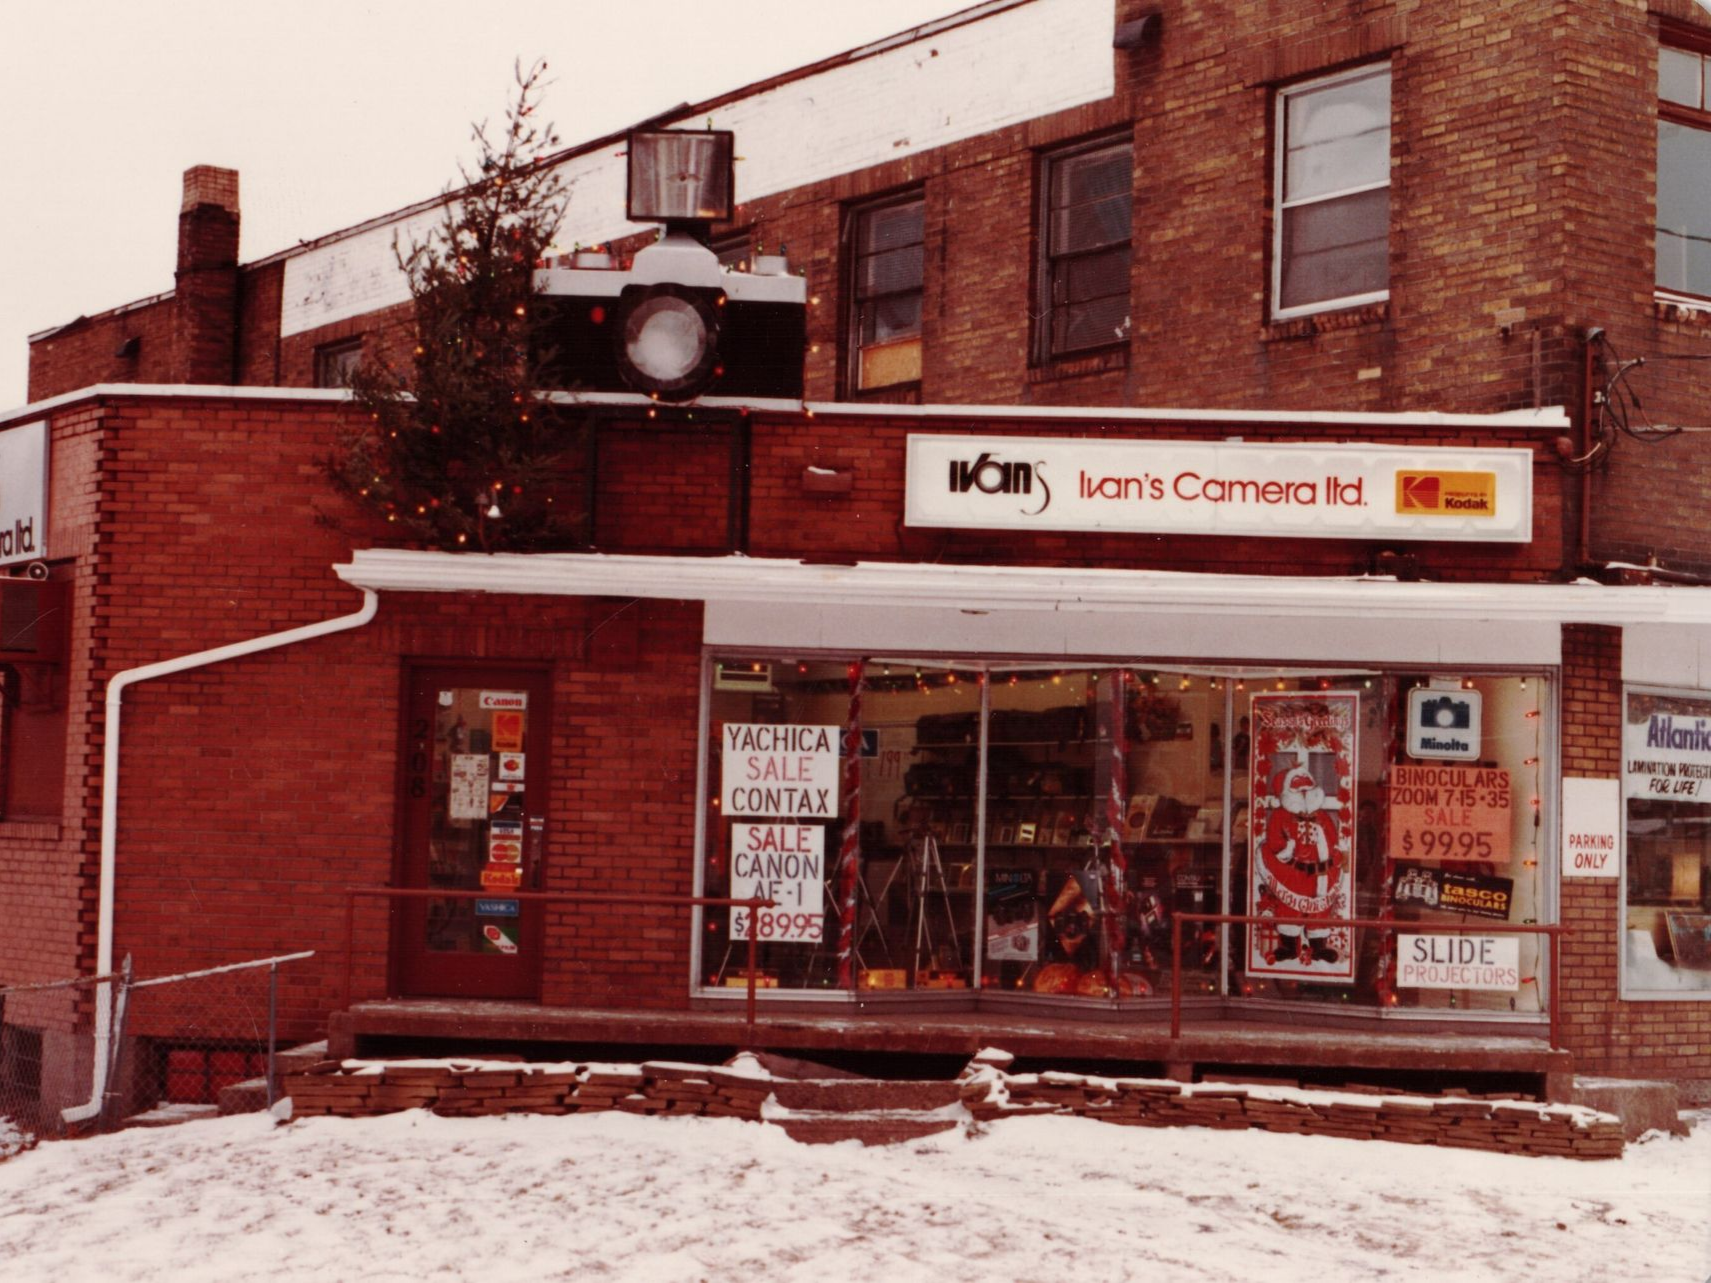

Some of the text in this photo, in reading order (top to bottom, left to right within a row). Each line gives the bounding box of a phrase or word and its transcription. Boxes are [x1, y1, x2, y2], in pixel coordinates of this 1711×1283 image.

[1079, 470, 1368, 507] Ivan's Camera ltd.
[1445, 497, 1489, 510] Kodak
[484, 696, 523, 707] Canon
[727, 725, 831, 752] YACHICA
[1420, 737, 1470, 752] Minolta
[746, 756, 813, 782] SALE
[1395, 767, 1509, 789] BINOCULARS
[1627, 760, 1676, 777] LAMINATION
[1649, 778, 1671, 794] FOR
[731, 787, 829, 814] CONTAX
[1391, 787, 1439, 807] ZOOM
[1424, 808, 1472, 827] SALE
[746, 826, 812, 853] SALE
[1569, 834, 1614, 850] PARKING
[734, 853, 820, 880] CANON
[1574, 853, 1608, 870] ONLY
[1443, 883, 1508, 902] tasco
[1440, 894, 1507, 911] BINOCULARS
[1412, 937, 1495, 965] SLIDE
[1403, 964, 1518, 986] PROJECTORS
